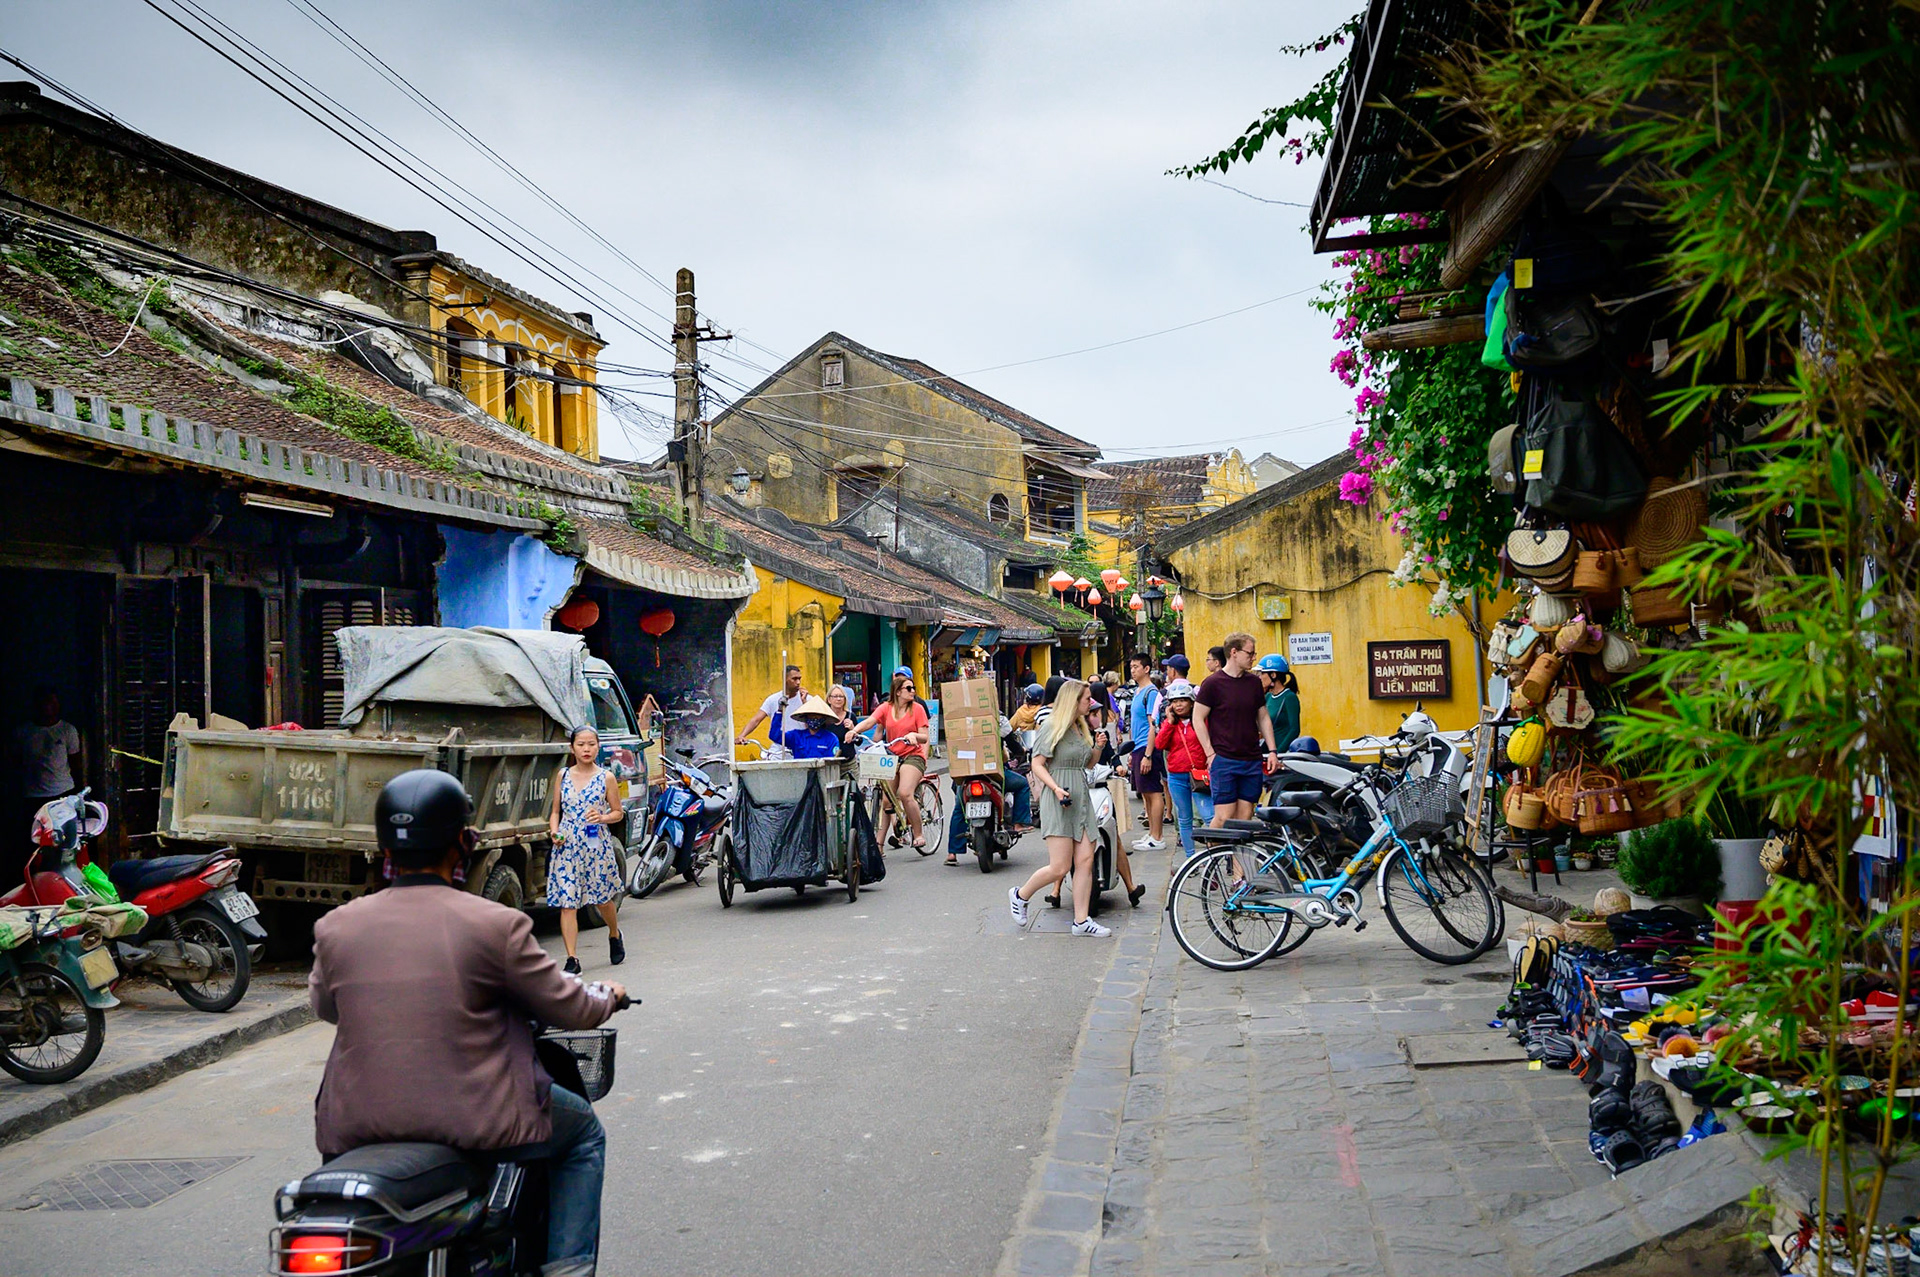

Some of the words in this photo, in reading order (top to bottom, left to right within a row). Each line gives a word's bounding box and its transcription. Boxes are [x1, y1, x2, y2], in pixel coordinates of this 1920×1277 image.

[1374, 651, 1388, 660] 94
[1421, 645, 1442, 659] PHÚ
[1375, 663, 1395, 677] BÁN
[1424, 664, 1444, 676] HOA
[880, 757, 894, 768] 06
[496, 782, 510, 806] 92C
